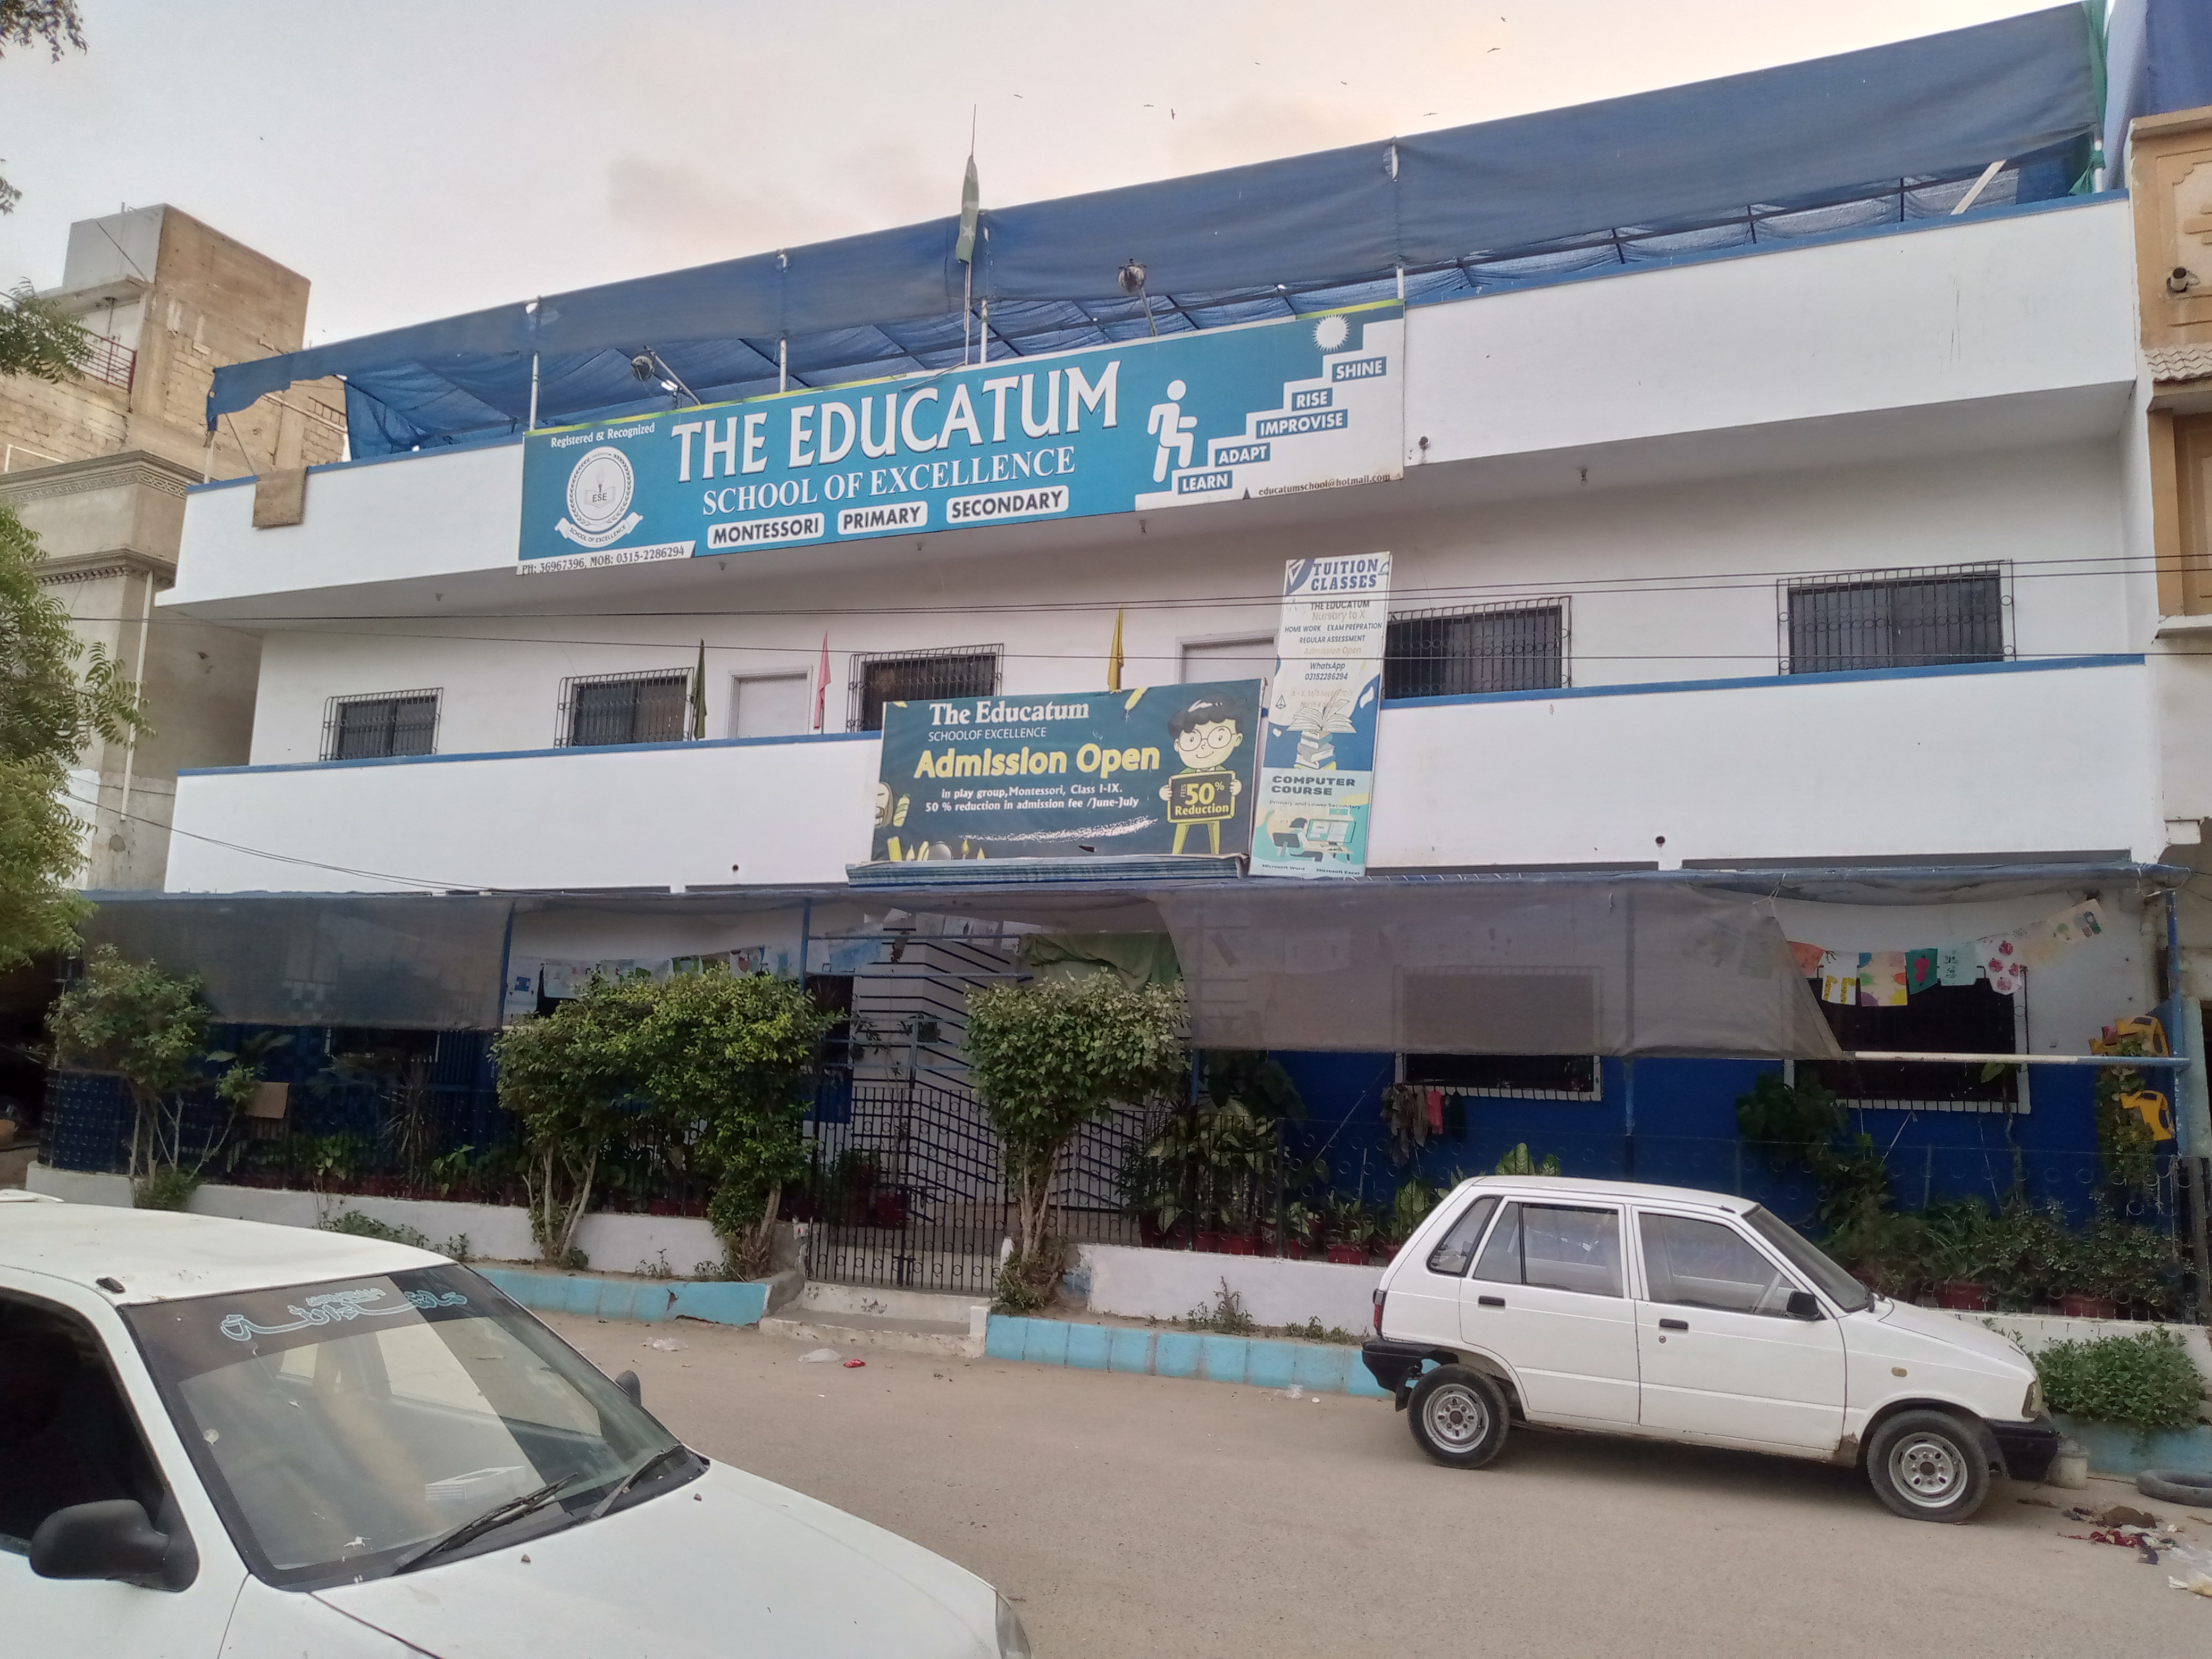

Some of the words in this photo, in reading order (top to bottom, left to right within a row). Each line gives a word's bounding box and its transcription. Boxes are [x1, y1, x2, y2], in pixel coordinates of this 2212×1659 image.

[1335, 359, 1384, 380] SHINE
[1295, 390, 1328, 409] RISE
[671, 412, 769, 483] THE
[788, 361, 1121, 470] EDUCATUM
[1260, 412, 1344, 436] IMPROVISE
[551, 432, 593, 448] Registered
[596, 431, 605, 442] &
[607, 422, 655, 439] Recognized
[1218, 445, 1268, 465] ADAPT
[703, 478, 818, 516] SCHOOL
[824, 472, 864, 501] OF
[869, 446, 1075, 497] EXCELLENCE
[1182, 473, 1228, 492] LEARN
[592, 492, 608, 502] ESE
[951, 490, 1063, 518] SECONDARY
[843, 506, 921, 531] PRIMARY
[569, 527, 587, 541] SCHOOL
[596, 524, 626, 543] EXCELLENCE
[713, 516, 819, 544] MONTESSORI
[522, 565, 537, 575] PH:
[590, 555, 614, 567] MOB:
[616, 545, 685, 564] 0315-2286294
[1313, 558, 1378, 576] TUITION
[1311, 574, 1377, 591] CLASSES
[1311, 602, 1325, 610] THE
[1326, 600, 1370, 609] EDUCATUM
[1348, 610, 1358, 619] to
[1359, 610, 1365, 618] X
[1328, 634, 1366, 643] ASSESSMENT
[1310, 661, 1346, 672] WhatsApp
[1305, 672, 1348, 681] 03152286294
[929, 702, 971, 726] The
[975, 700, 1089, 724] Educatum
[985, 726, 1047, 739] EXCELLENCE
[913, 745, 1067, 778] Admission
[1076, 743, 1160, 779] Open
[1271, 786, 1333, 795] COURSE
[1272, 776, 1355, 787] COMPUTER
[941, 788, 951, 799] in
[953, 788, 973, 799] play
[1070, 784, 1095, 795] Class
[925, 802, 939, 812] 50
[942, 801, 952, 812] %
[954, 800, 1001, 811] reduction
[1003, 800, 1014, 810] in
[1016, 799, 1064, 810] admission
[1068, 798, 1083, 808] fee
[1086, 797, 1139, 809] /June-July
[1175, 802, 1230, 816] Reduction
